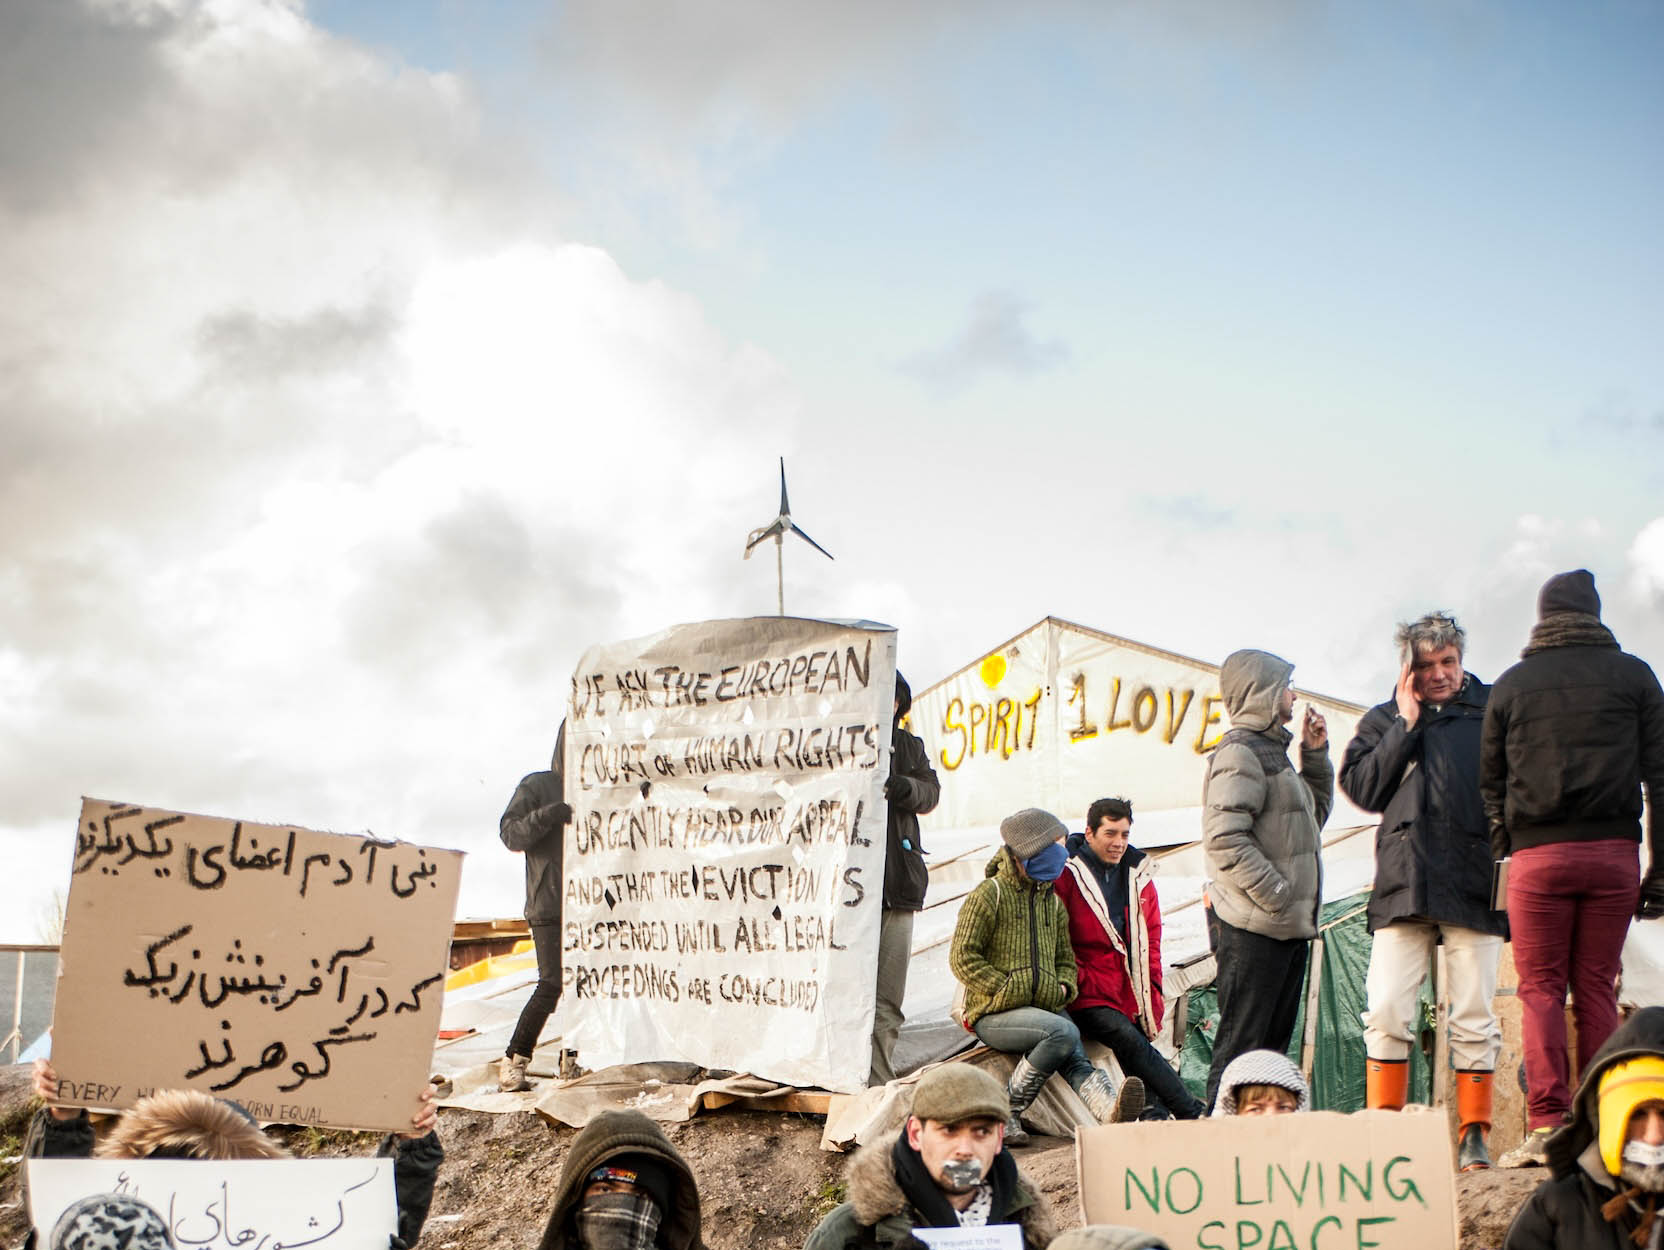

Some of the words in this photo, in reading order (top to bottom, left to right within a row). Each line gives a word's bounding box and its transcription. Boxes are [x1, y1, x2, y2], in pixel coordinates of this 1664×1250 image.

[572, 673, 605, 721] WE
[616, 668, 653, 713] ASK
[654, 665, 712, 708] THE
[714, 638, 872, 703] EUROPEAN
[940, 687, 1043, 771] SPIRIT
[1106, 676, 1224, 755] LOVE
[580, 743, 650, 790] COURT
[654, 754, 676, 777] OF
[685, 734, 764, 775] HUMAN
[774, 723, 880, 770] RIGHTS
[576, 806, 680, 855] URGENTLY
[684, 806, 743, 850] HEAR
[747, 806, 784, 846] OUR
[786, 800, 873, 849] APPEAL
[566, 873, 603, 905] AND
[607, 871, 656, 903] THAT
[660, 870, 689, 901] THE
[702, 864, 822, 904] EVICTION
[829, 863, 865, 908] IS
[564, 919, 668, 952] SUSPENDED
[675, 919, 727, 954] UNTIL
[734, 916, 777, 953] ALL
[784, 915, 847, 951] LEGAL
[561, 962, 680, 1003] PROCEEDINGS
[688, 978, 713, 1005] ARE
[719, 972, 819, 1014] CONCLUDED
[57, 1079, 121, 1103] EVERY
[236, 1099, 274, 1120] ORN
[279, 1104, 329, 1124] EQUAL
[1125, 1165, 1204, 1215] NO
[1235, 1155, 1429, 1210] LIVING
